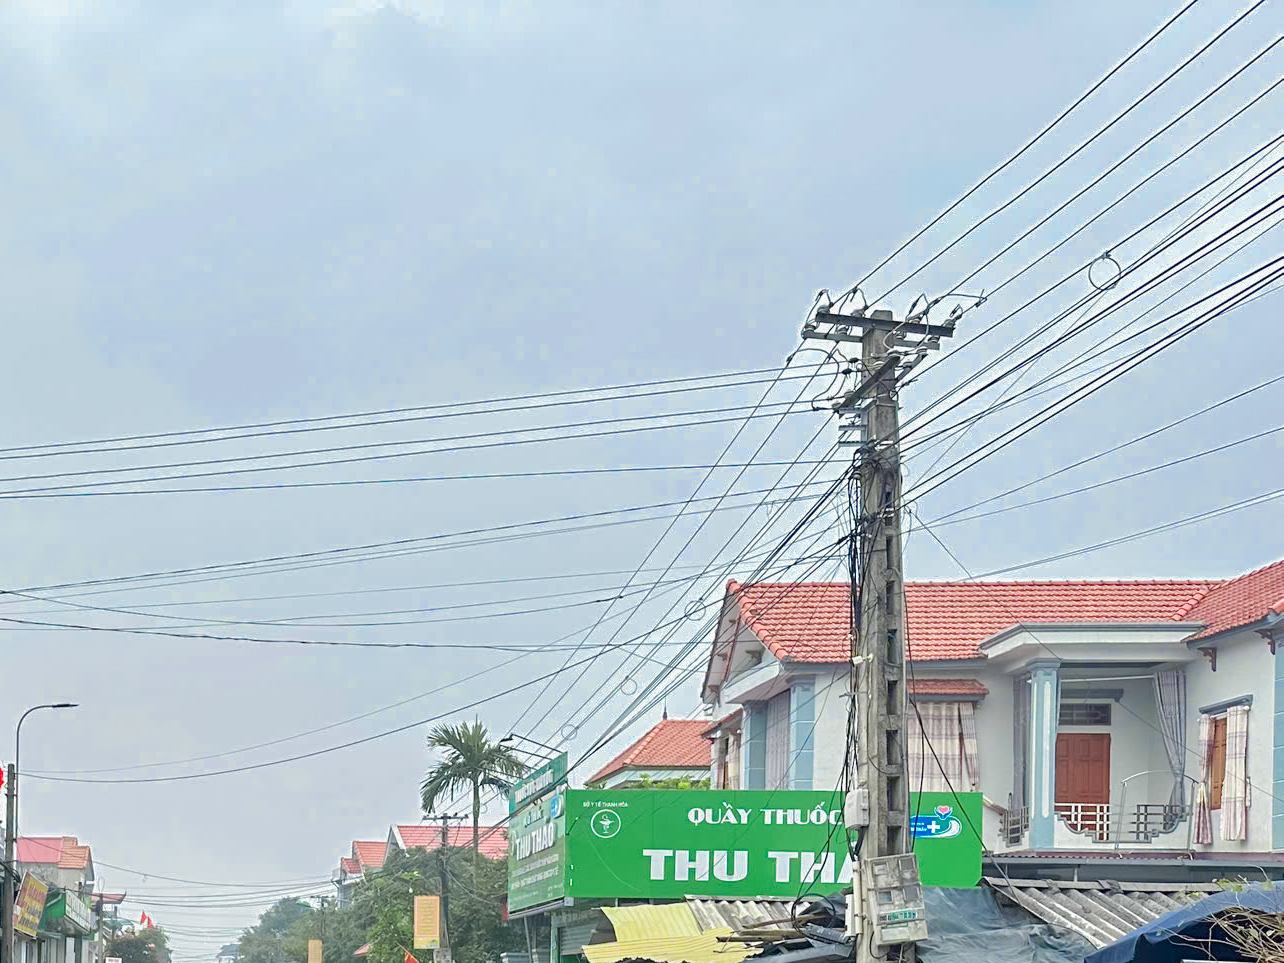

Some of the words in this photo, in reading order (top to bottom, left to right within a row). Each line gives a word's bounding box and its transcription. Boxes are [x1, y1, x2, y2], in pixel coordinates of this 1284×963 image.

[688, 801, 752, 826] QUẦY
[760, 801, 843, 825] THUỐC
[515, 833, 531, 861] THU
[642, 849, 749, 882] THU
[767, 848, 855, 884] TH
